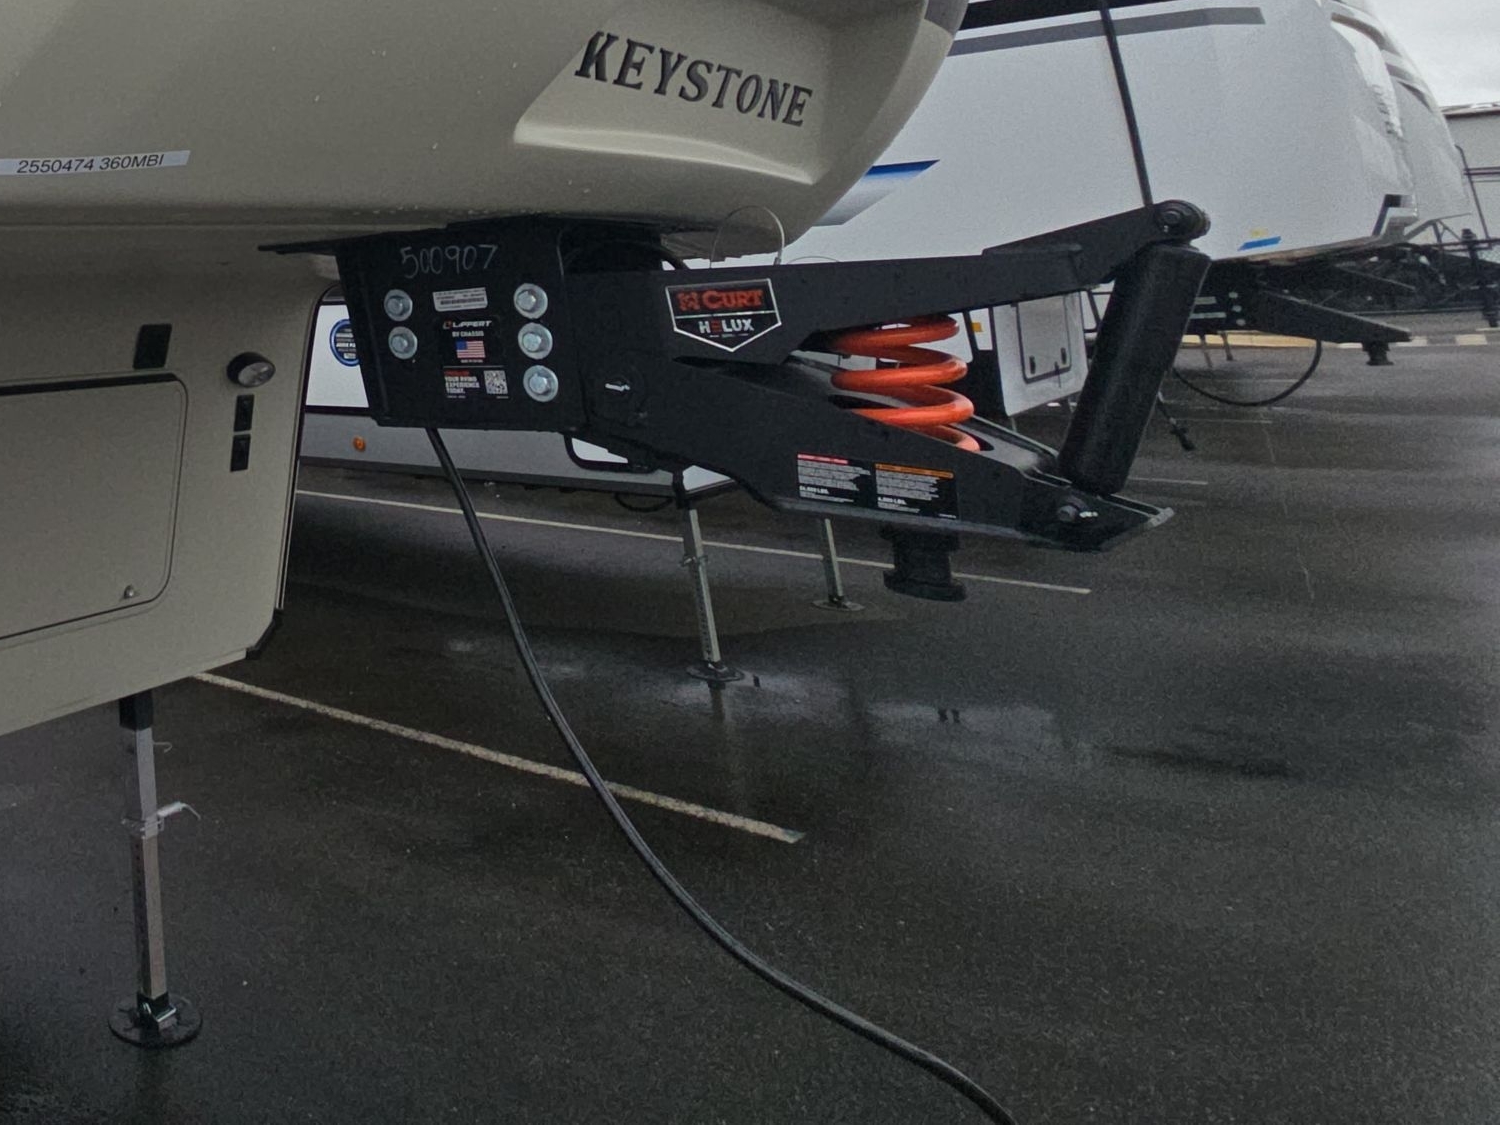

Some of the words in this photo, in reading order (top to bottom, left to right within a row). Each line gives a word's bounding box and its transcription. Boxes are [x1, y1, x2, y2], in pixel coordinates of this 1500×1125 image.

[574, 30, 814, 127] KEYSTONE
[16, 159, 95, 174] 2550474
[99, 154, 165, 170] 360MBI
[399, 243, 499, 279] 500907
[698, 318, 755, 334] HELUX
